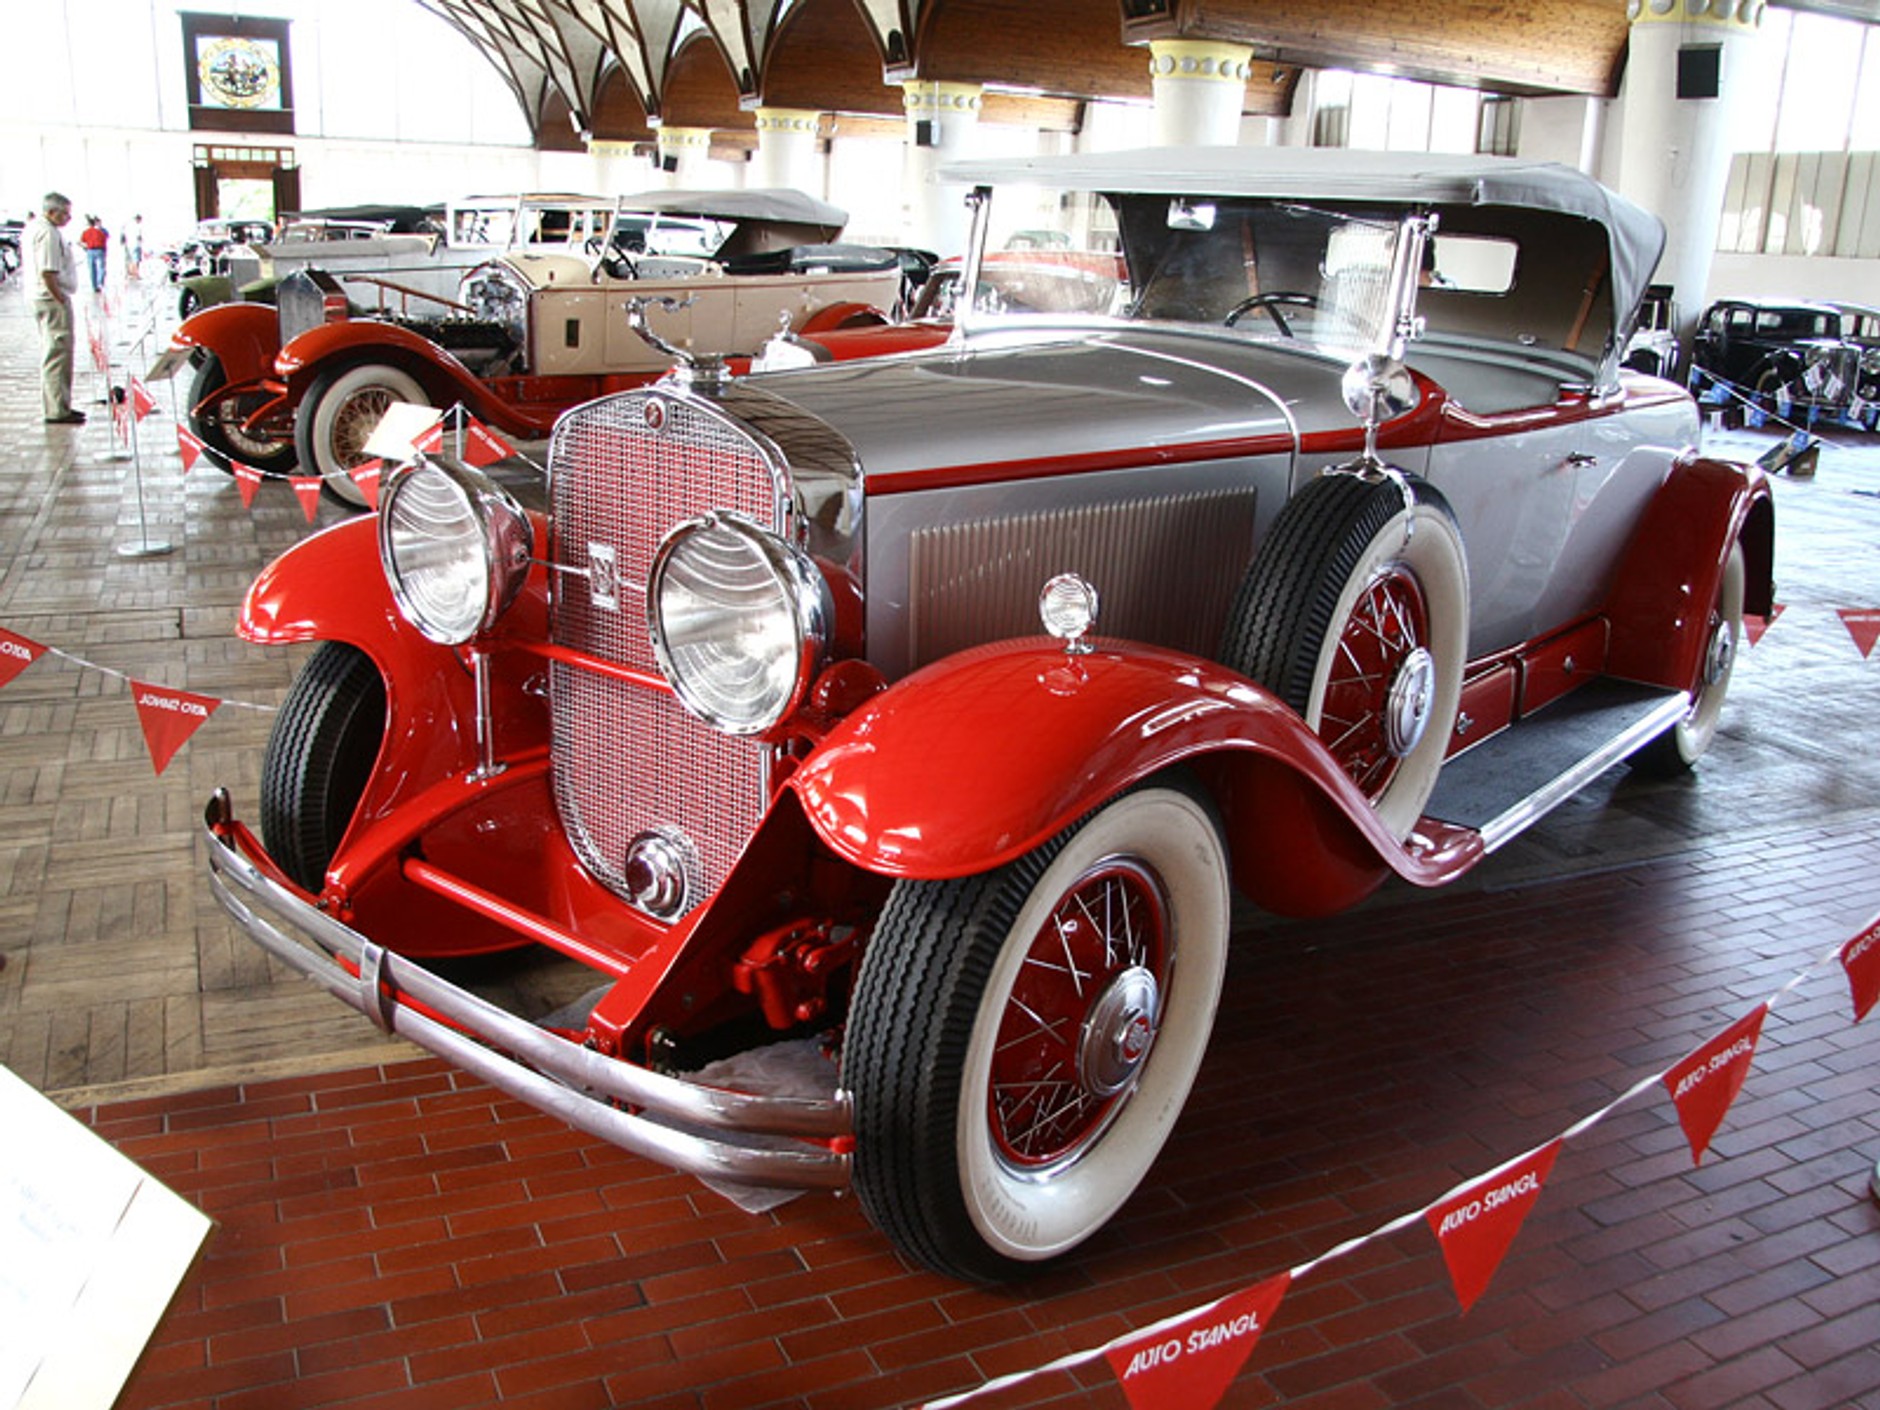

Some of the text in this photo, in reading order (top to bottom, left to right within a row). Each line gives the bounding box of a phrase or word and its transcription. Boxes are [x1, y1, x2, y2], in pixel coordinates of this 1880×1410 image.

[1438, 1171, 1540, 1238] AUTO STANGL
[1123, 1311, 1259, 1380] AUTO STANGL
